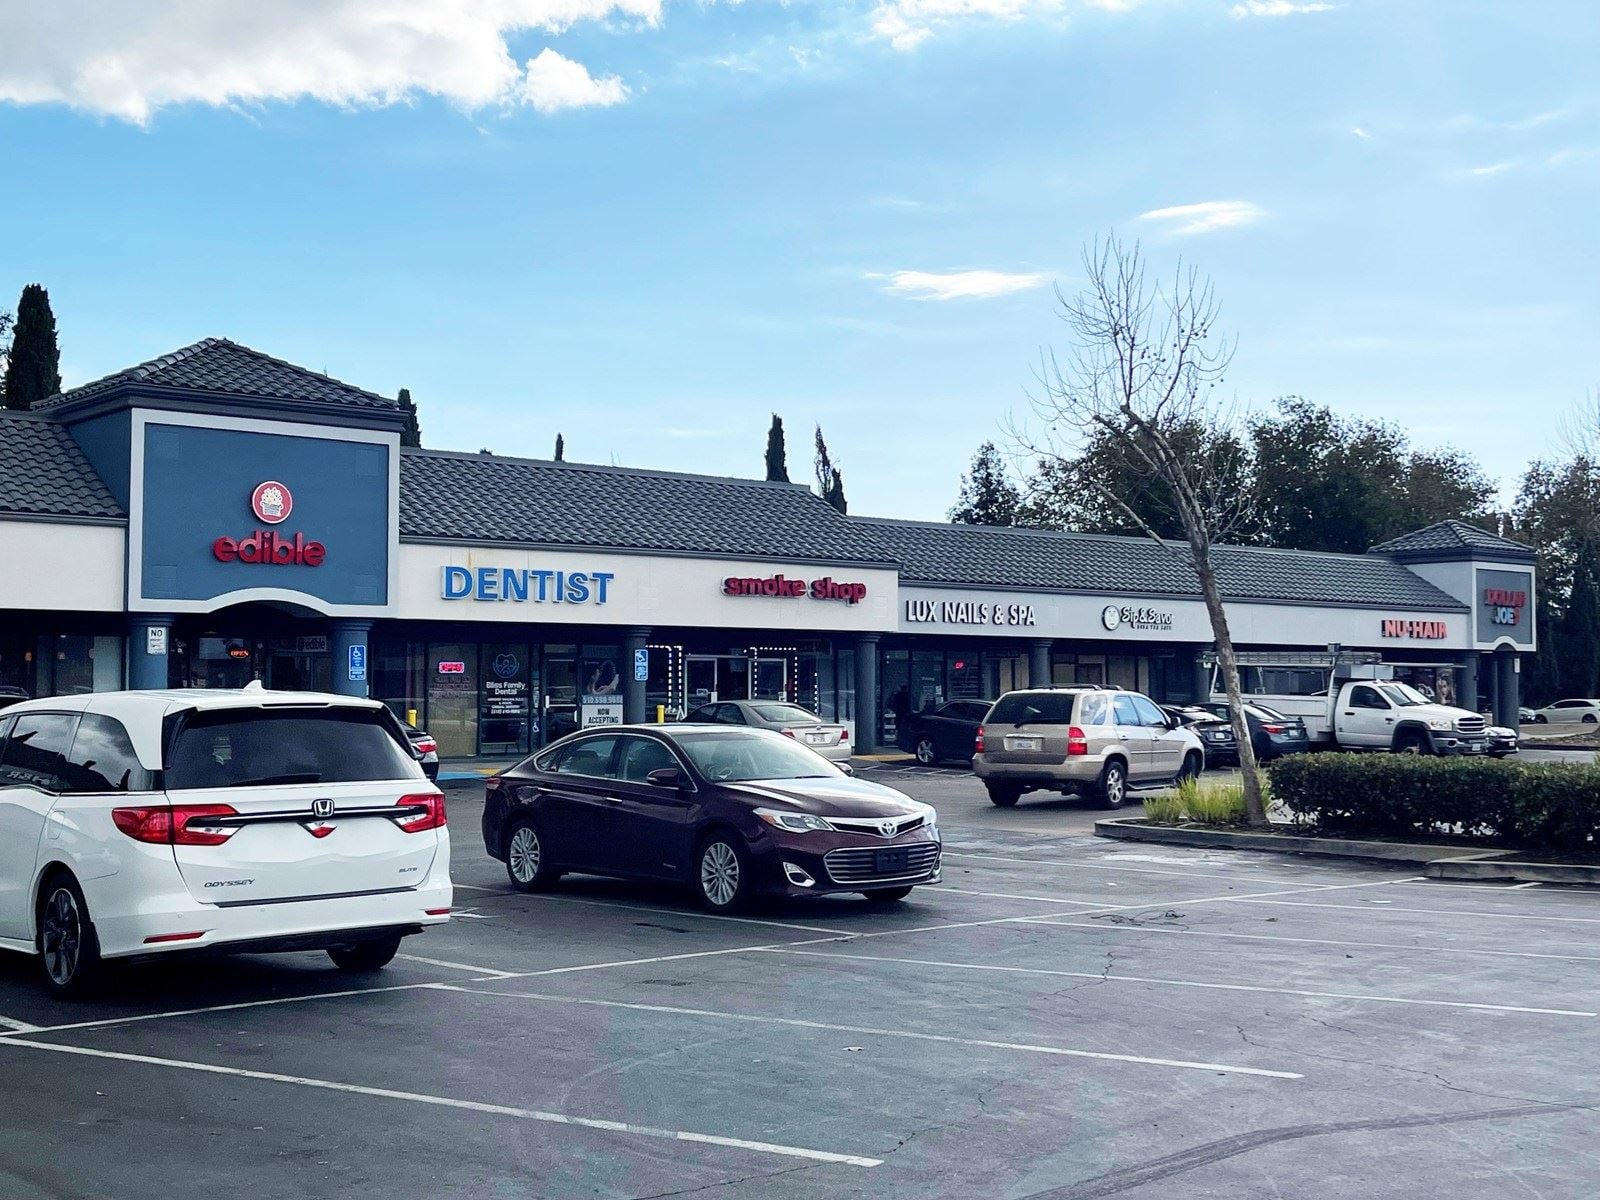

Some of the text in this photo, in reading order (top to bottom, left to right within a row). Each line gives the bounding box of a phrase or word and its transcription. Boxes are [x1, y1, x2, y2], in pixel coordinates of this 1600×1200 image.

[213, 530, 326, 566] edible
[441, 566, 615, 605] DENTIST
[721, 574, 867, 607] smoke shop
[906, 600, 1036, 626] LUX NAILS & SPA
[151, 629, 162, 637] NO
[1381, 620, 1447, 639] NU-HAIR
[503, 681, 526, 690] Family
[597, 708, 610, 716] NOW
[588, 716, 619, 724] ACCEPTING
[204, 879, 256, 888] ODYSSEY
